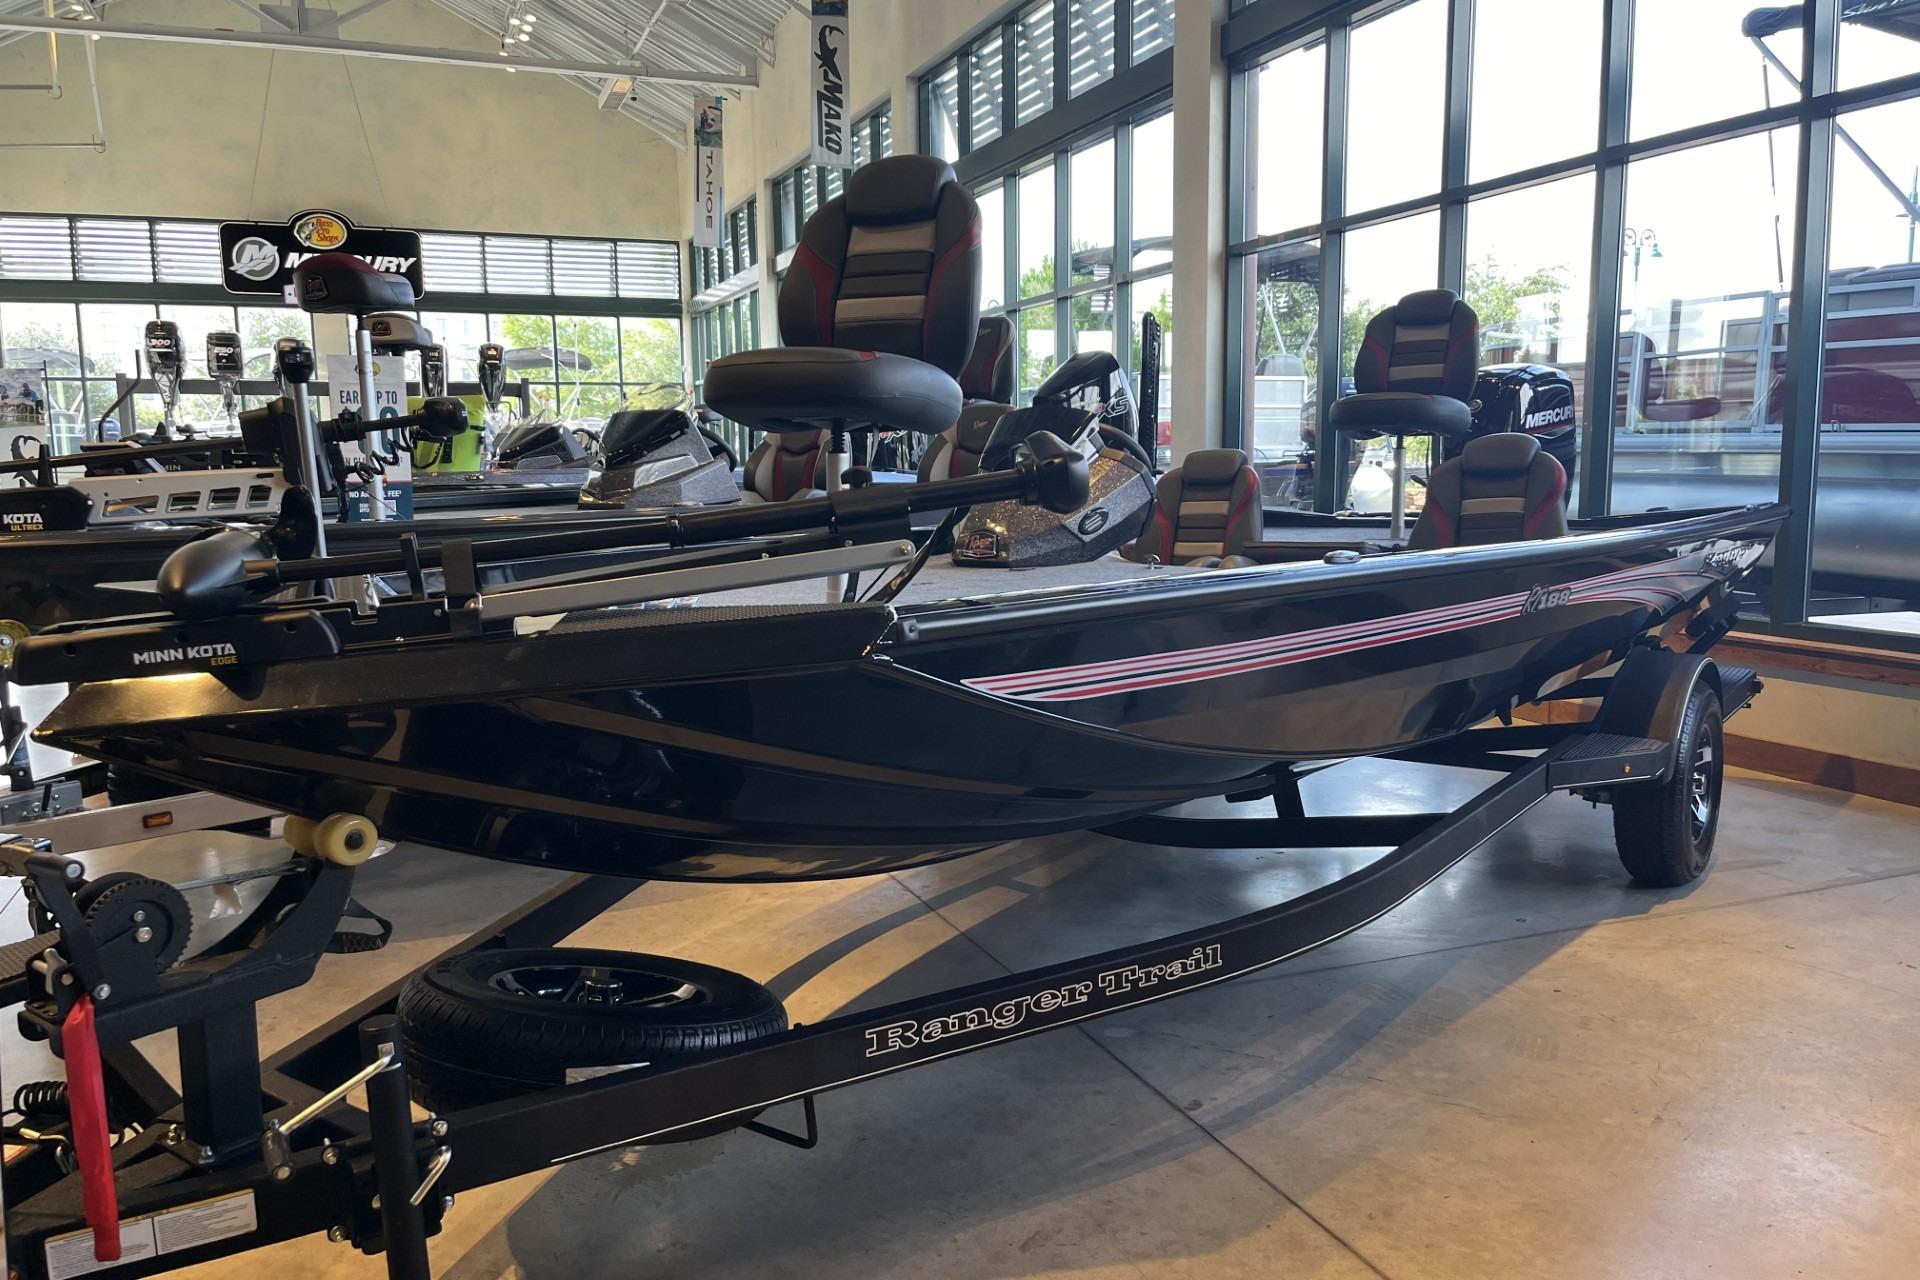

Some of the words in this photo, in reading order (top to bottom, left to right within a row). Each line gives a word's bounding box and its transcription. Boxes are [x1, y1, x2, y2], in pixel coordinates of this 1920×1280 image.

[817, 68, 844, 156] MAKO
[705, 149, 713, 229] TAHOE
[317, 234, 340, 243] Shops
[340, 390, 360, 404] EAR
[385, 391, 398, 404] TO
[1525, 405, 1574, 429] MERCUR
[2, 513, 43, 525] KOTA
[133, 647, 185, 665] MINN
[187, 643, 237, 659] KOTA
[210, 656, 239, 666] EDGE
[866, 981, 1093, 1057] Ranger
[1099, 944, 1223, 996] Trail
